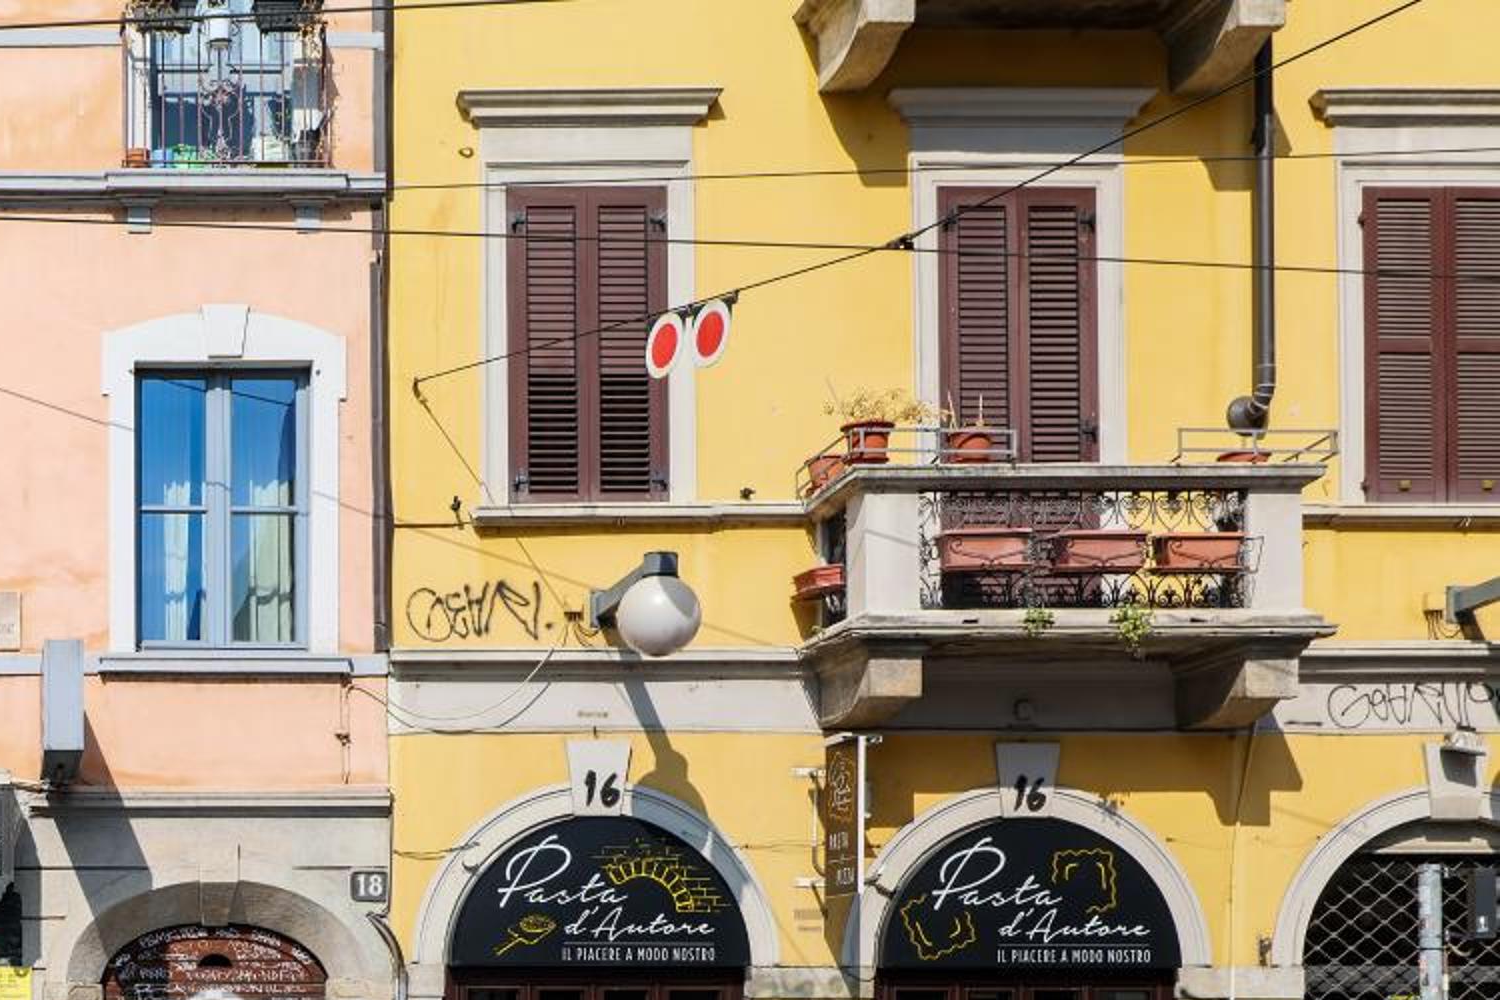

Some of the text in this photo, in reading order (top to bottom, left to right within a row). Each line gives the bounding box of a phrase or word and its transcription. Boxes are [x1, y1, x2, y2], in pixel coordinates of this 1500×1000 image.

[584, 769, 621, 808] 16
[1013, 773, 1047, 812] 16
[357, 874, 383, 897] 18
[497, 833, 629, 909] Pasta
[931, 836, 1063, 911] Pasta
[563, 905, 716, 942] d'Autore
[998, 907, 1151, 944] d'Autore
[561, 946, 716, 962] IL PIACERE A MODO NOSTRO
[996, 949, 1151, 964] IL PIACERE A MODO NOSTRO
